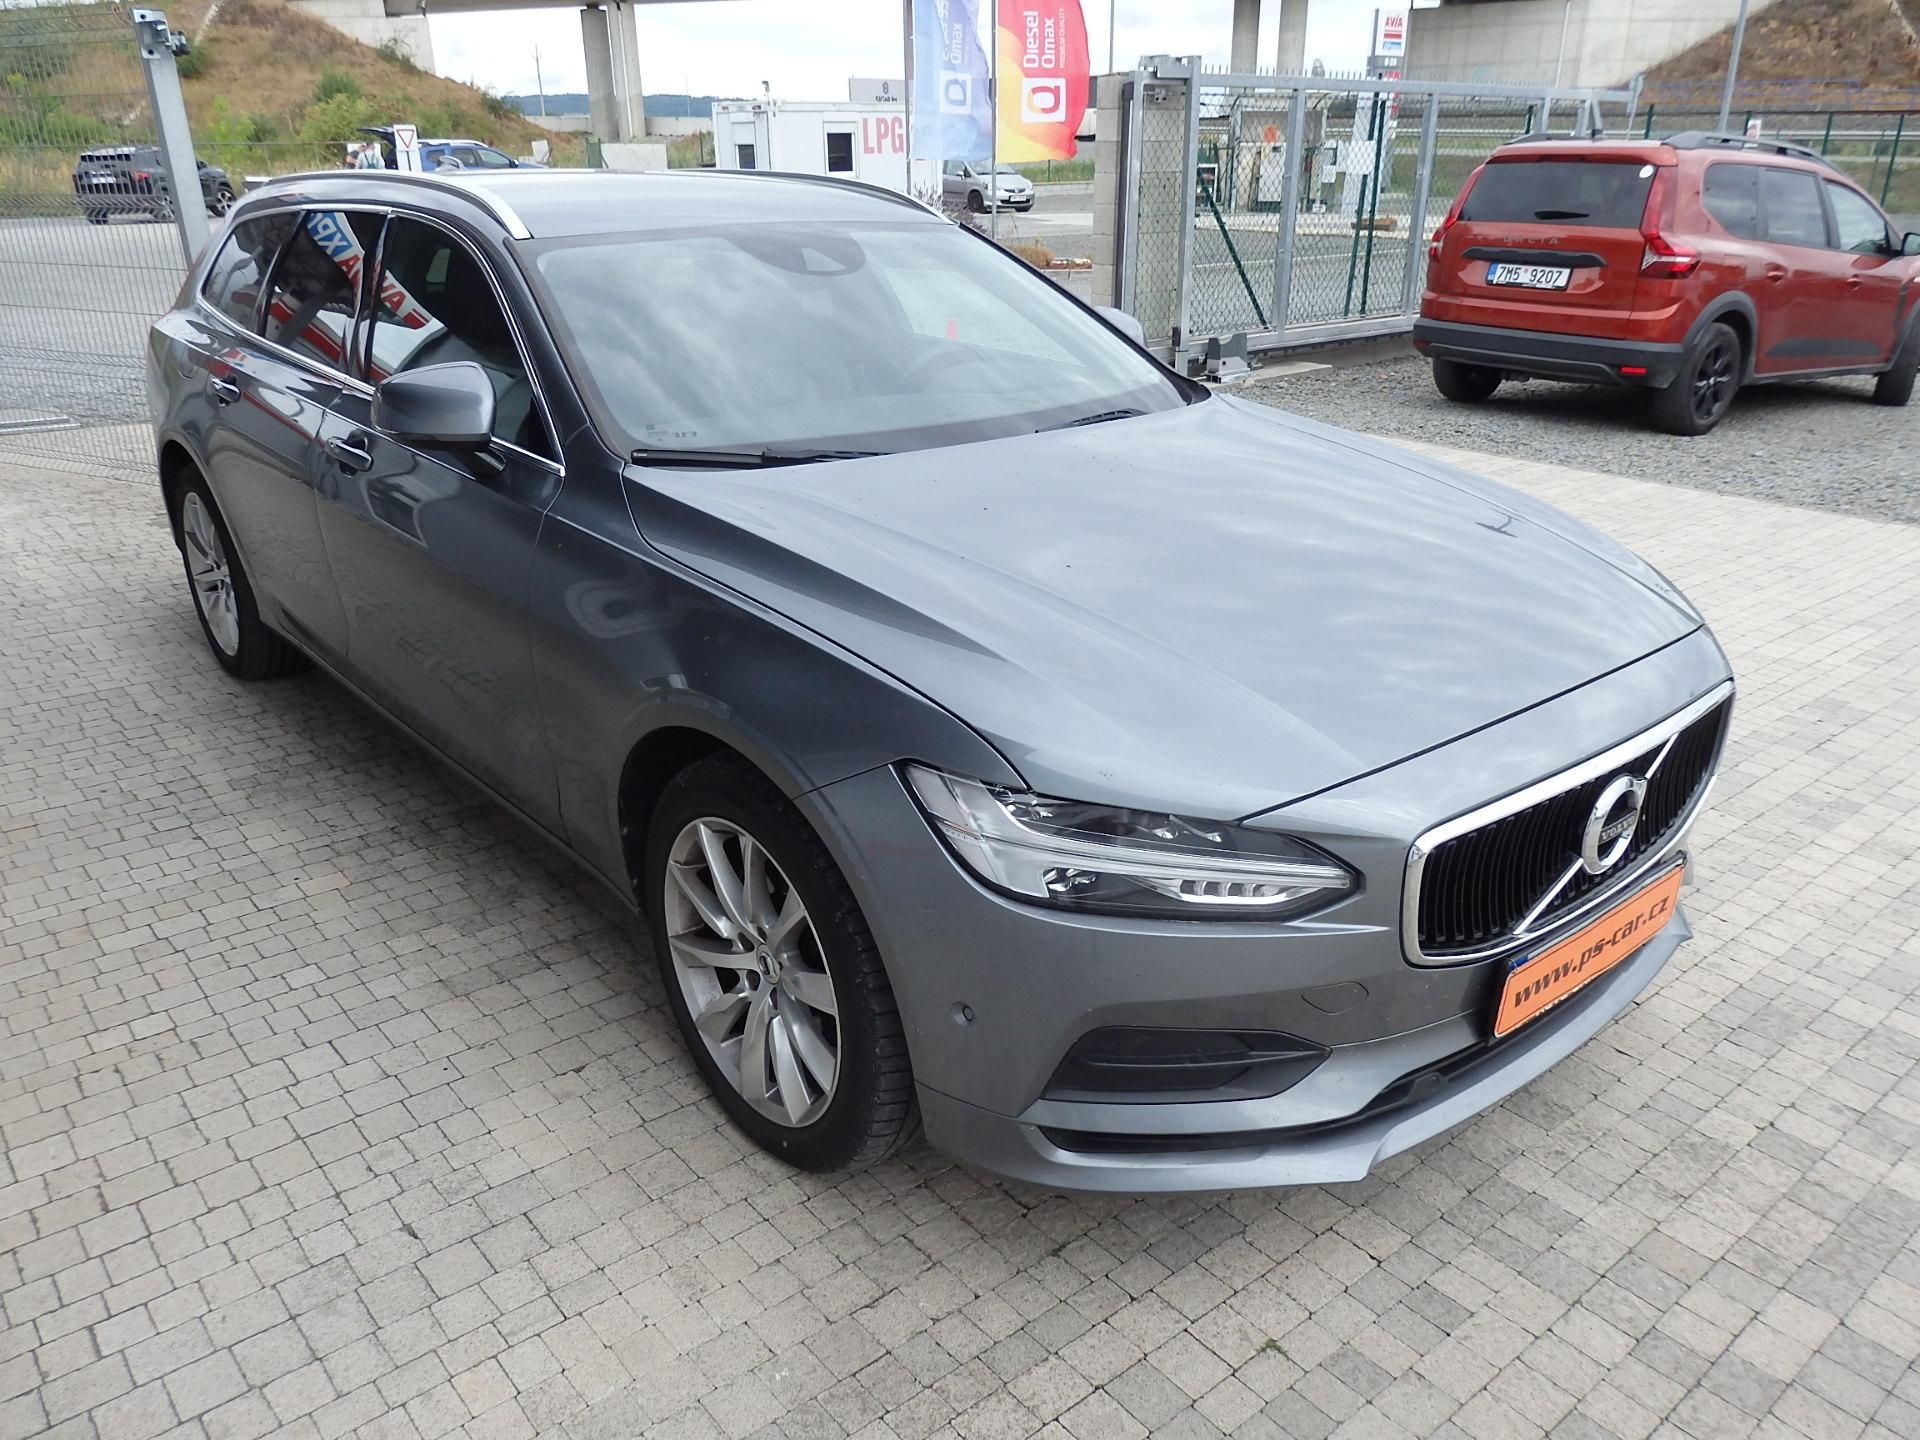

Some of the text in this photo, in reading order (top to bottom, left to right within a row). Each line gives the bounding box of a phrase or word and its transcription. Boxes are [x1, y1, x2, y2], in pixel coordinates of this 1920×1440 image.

[1384, 14, 1403, 28] AVIA
[1023, 10, 1039, 68] Diesel
[862, 116, 904, 155] LPG
[1497, 266, 1563, 285] 7M5 9207
[1601, 815, 1637, 840] VOLVO
[1514, 895, 1669, 1008] www.ps-car.cz
